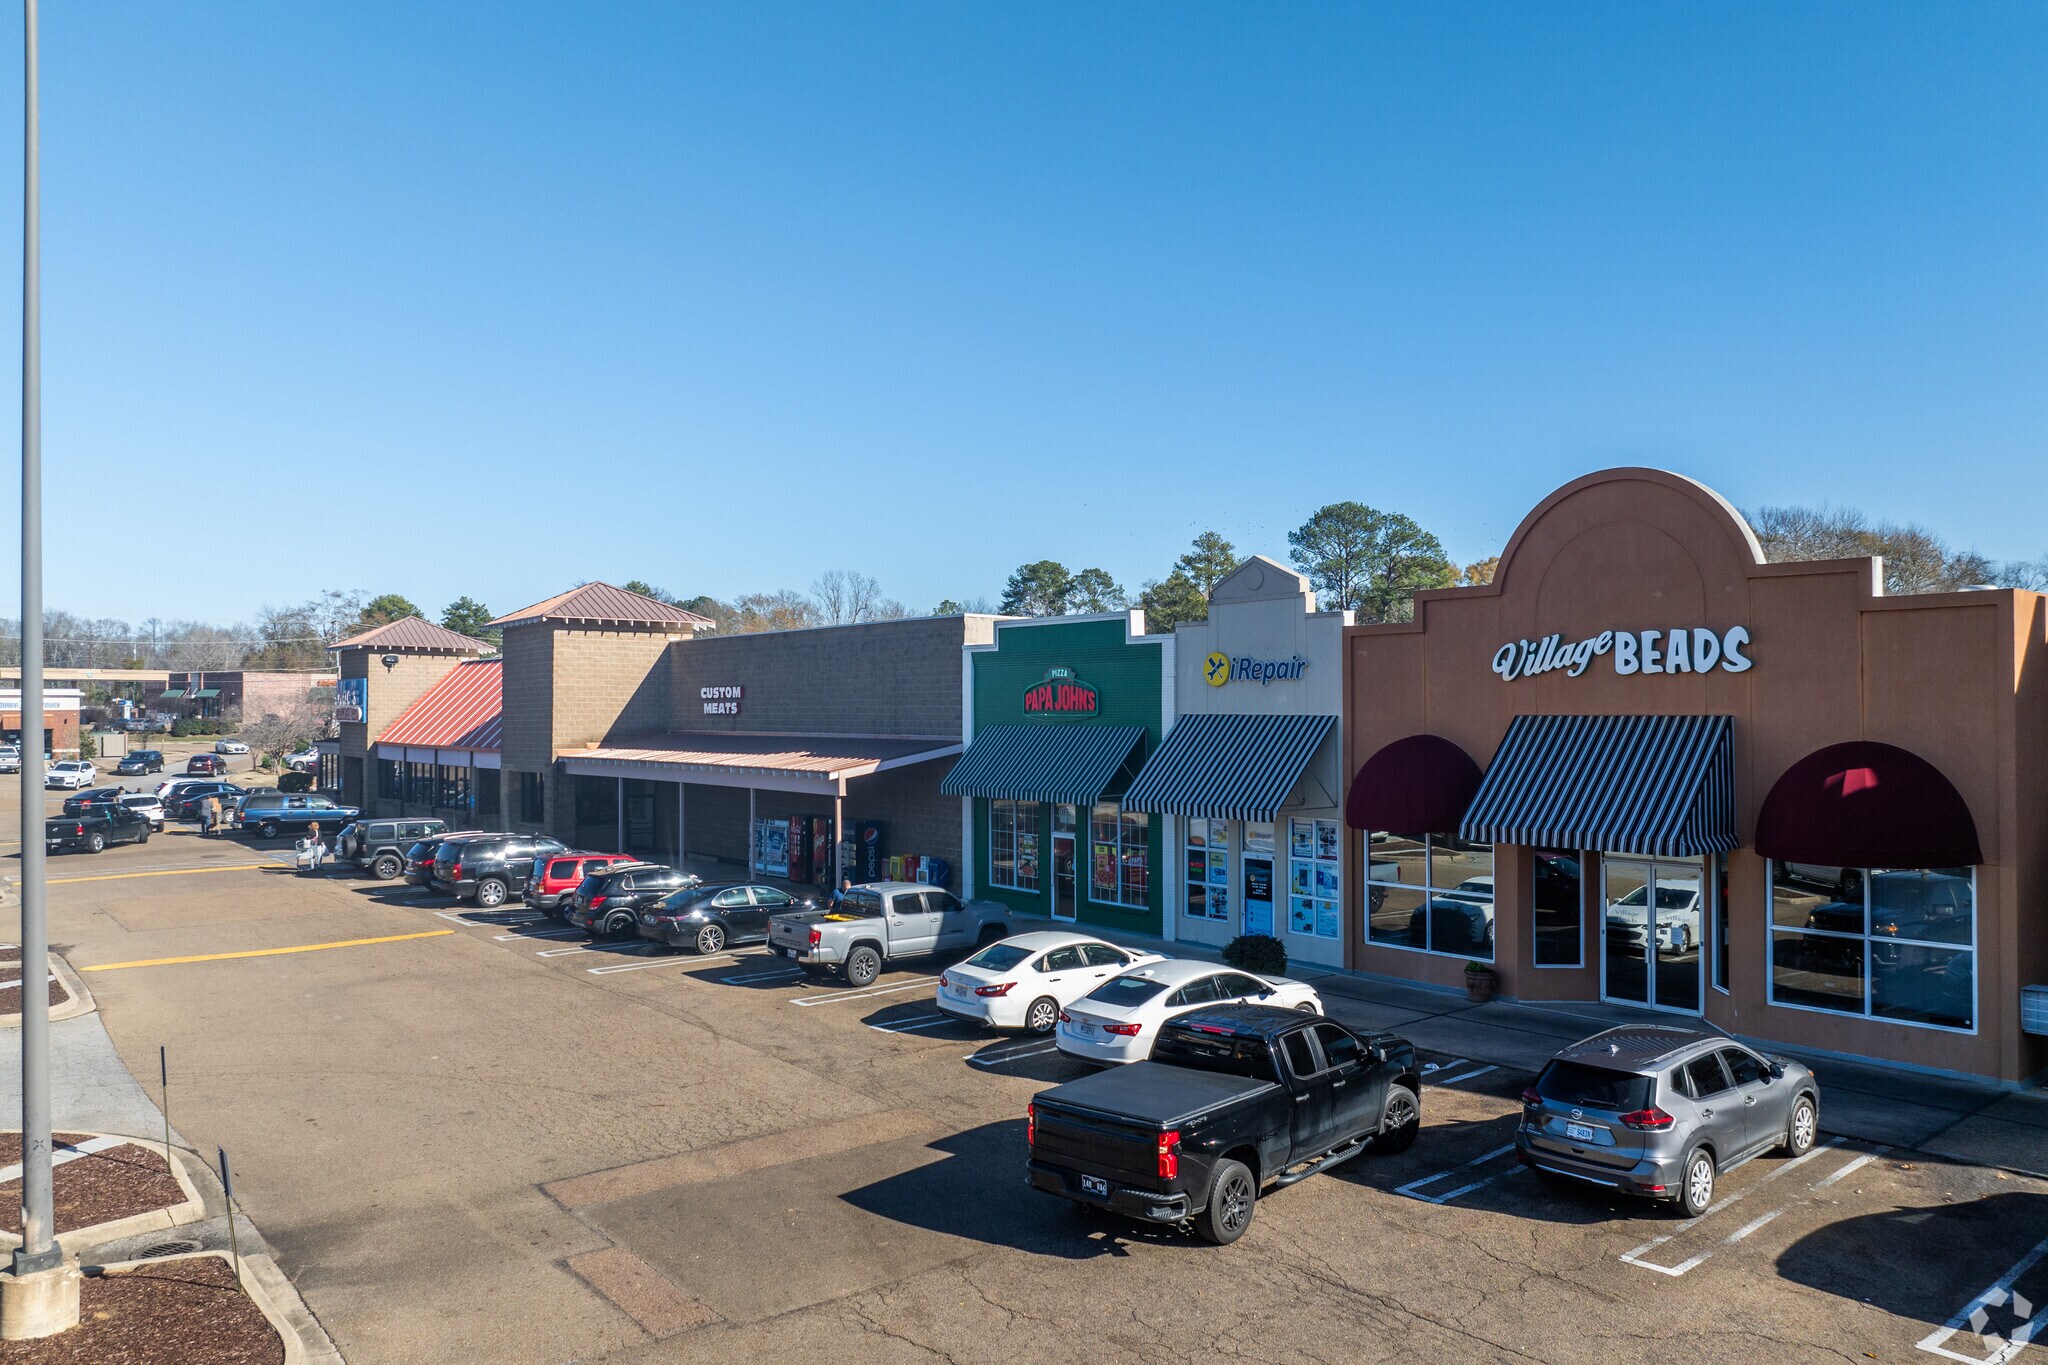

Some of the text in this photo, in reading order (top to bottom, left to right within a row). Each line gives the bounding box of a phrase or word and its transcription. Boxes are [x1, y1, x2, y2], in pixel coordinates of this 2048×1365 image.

[1492, 626, 1752, 682] Village BEADS
[1051, 669, 1068, 677] PIZZA
[700, 686, 742, 699] CUSTOM
[1025, 684, 1096, 711] PAPA JOHN'S
[703, 702, 739, 715] MEATS
[1614, 909, 1639, 917] Village
